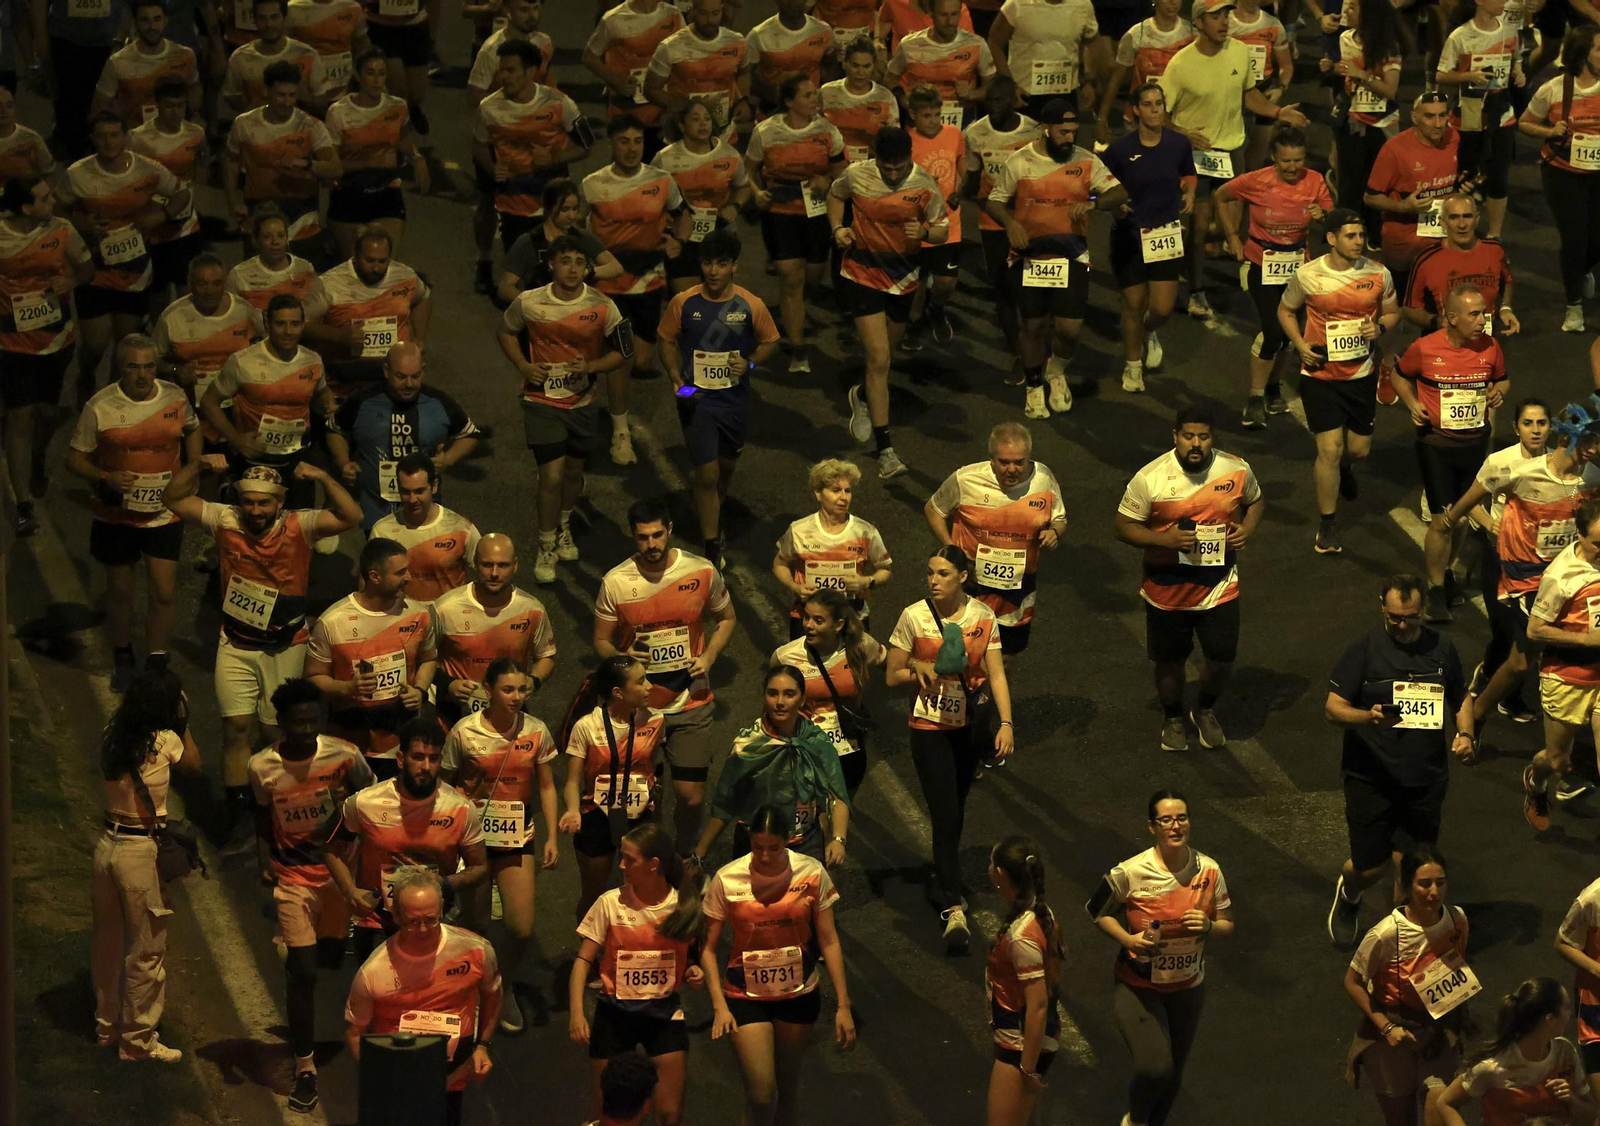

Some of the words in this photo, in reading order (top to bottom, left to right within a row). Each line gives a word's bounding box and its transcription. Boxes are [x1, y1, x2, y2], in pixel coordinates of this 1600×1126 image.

[1036, 73, 1067, 85] 21518
[1200, 158, 1224, 169] 4561
[1065, 167, 1082, 177] KH7
[105, 238, 139, 255] 20310
[1150, 237, 1176, 251] 3419
[1029, 264, 1062, 277] 13447
[1356, 281, 1373, 290] KH7
[18, 303, 55, 320] 22003
[365, 333, 391, 345] 5789
[703, 367, 731, 379] 1500
[1450, 406, 1478, 418] 3670
[391, 414, 406, 424] IN
[392, 425, 411, 434] DO
[265, 432, 294, 444] 9513
[392, 435, 414, 446] MA
[1214, 480, 1235, 493] KH7
[133, 488, 161, 501] 4729
[1028, 498, 1046, 510] KH7
[435, 538, 455, 550] KH7
[984, 564, 1014, 579] 5423
[678, 579, 699, 592] KH7
[814, 576, 845, 590] 5426
[228, 592, 265, 616] 22214
[399, 621, 418, 635] KH7
[511, 619, 529, 630] KH7
[652, 645, 685, 660] 0260
[1398, 700, 1434, 716] 23451
[637, 727, 655, 738] KH7
[515, 740, 533, 751] KH7
[284, 804, 328, 822] 24184
[430, 816, 453, 829] KH7
[483, 819, 517, 833] 8544
[446, 960, 470, 977] KH7
[1158, 954, 1198, 971] 23894
[623, 970, 668, 986] 18553
[751, 966, 795, 983] 18731
[1427, 969, 1467, 1004] 21040
